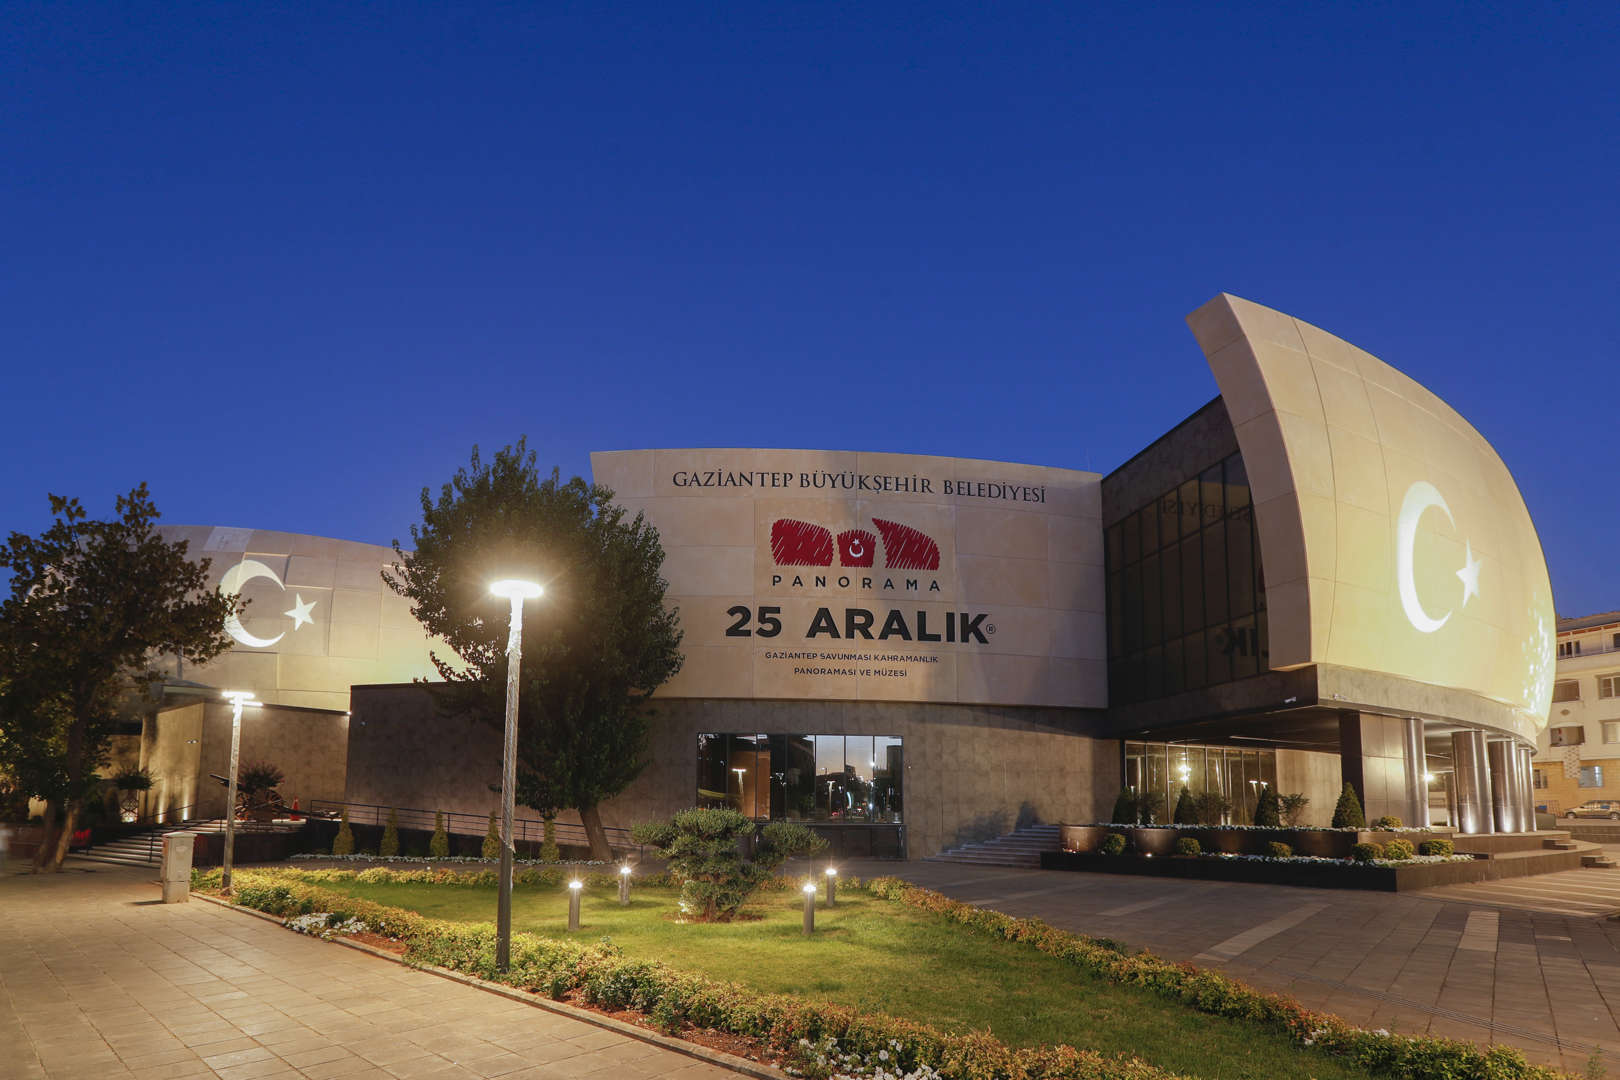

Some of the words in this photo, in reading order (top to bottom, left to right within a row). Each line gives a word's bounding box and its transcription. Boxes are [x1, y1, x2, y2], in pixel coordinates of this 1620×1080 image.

[672, 469, 794, 488] GAZİANTEP
[799, 470, 934, 494] BÜYÜKŞEHİR
[943, 480, 1046, 504] BELEDİYESİ
[772, 575, 941, 592] PANORAMA
[725, 605, 782, 638] 25
[819, 652, 872, 662] SAVUNMASI
[873, 655, 939, 664] KAHRAMANLIK
[793, 667, 856, 676] PANORAMASI
[859, 669, 872, 677] VE
